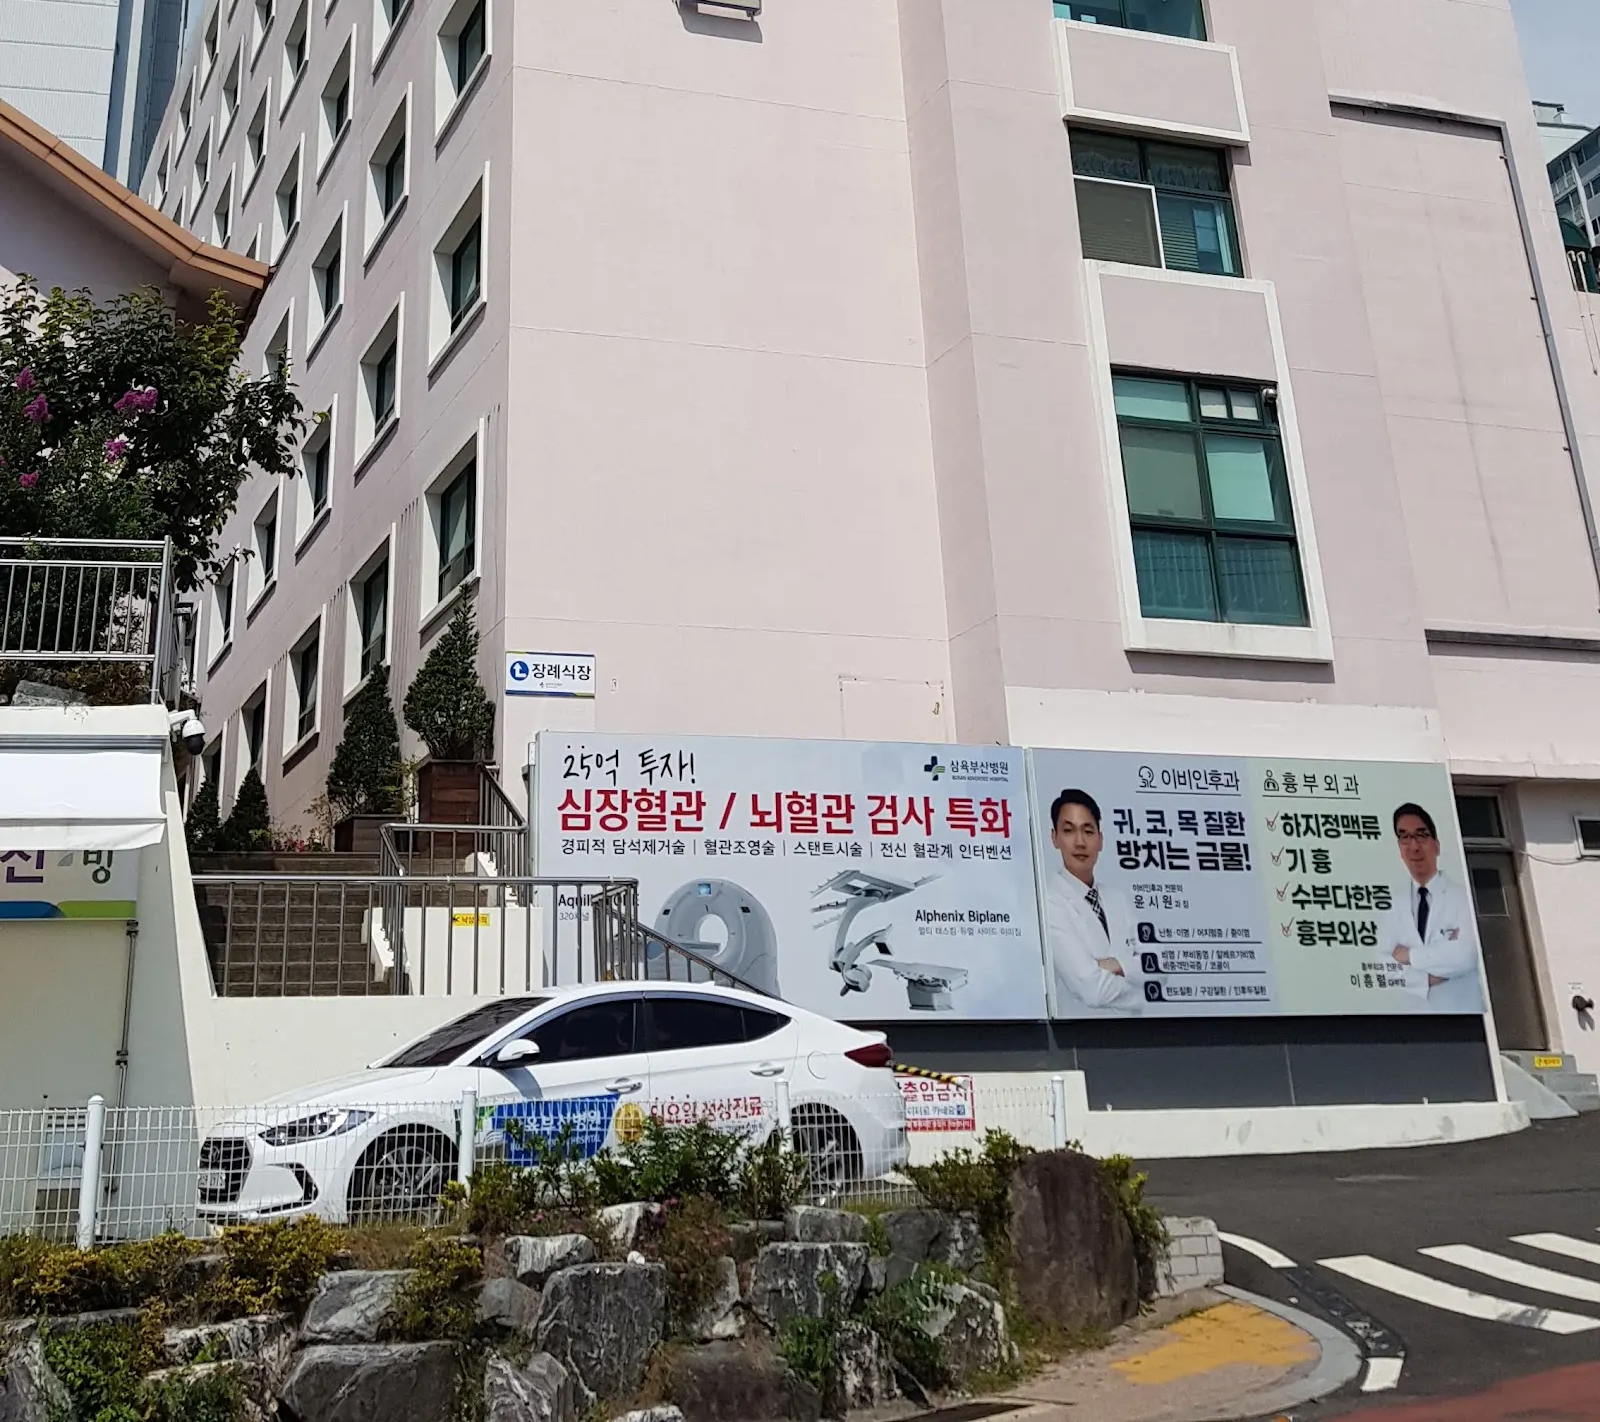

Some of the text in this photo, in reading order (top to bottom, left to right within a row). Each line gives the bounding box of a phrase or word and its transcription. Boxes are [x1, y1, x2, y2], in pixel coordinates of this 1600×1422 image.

[531, 663, 592, 681] 장례식장
[562, 748, 696, 787] 25억 투자!
[949, 760, 1009, 775] 삼육부산병원
[1161, 768, 1241, 792] 이비인후과
[556, 788, 707, 833] 심장혈관
[750, 790, 856, 835] 뇌혈관
[866, 794, 935, 837] 검사
[945, 796, 1013, 839] 특화
[1112, 808, 1246, 838] 귀, 코, 목 질환
[1280, 813, 1382, 840] 하지정맥류
[561, 838, 1013, 861] 경피적 담석제거술 혈관조영술 스탠트시술 전신 혈관계 인터벤션
[1115, 840, 1253, 872] 방치는 금물!
[1291, 884, 1393, 911] 수부다한증
[915, 909, 1010, 925] Alphenix Biplane
[1296, 919, 1379, 948] 흉부외상
[897, 1080, 968, 1102] 출입금지
[509, 1109, 601, 1136] 육부산병원
